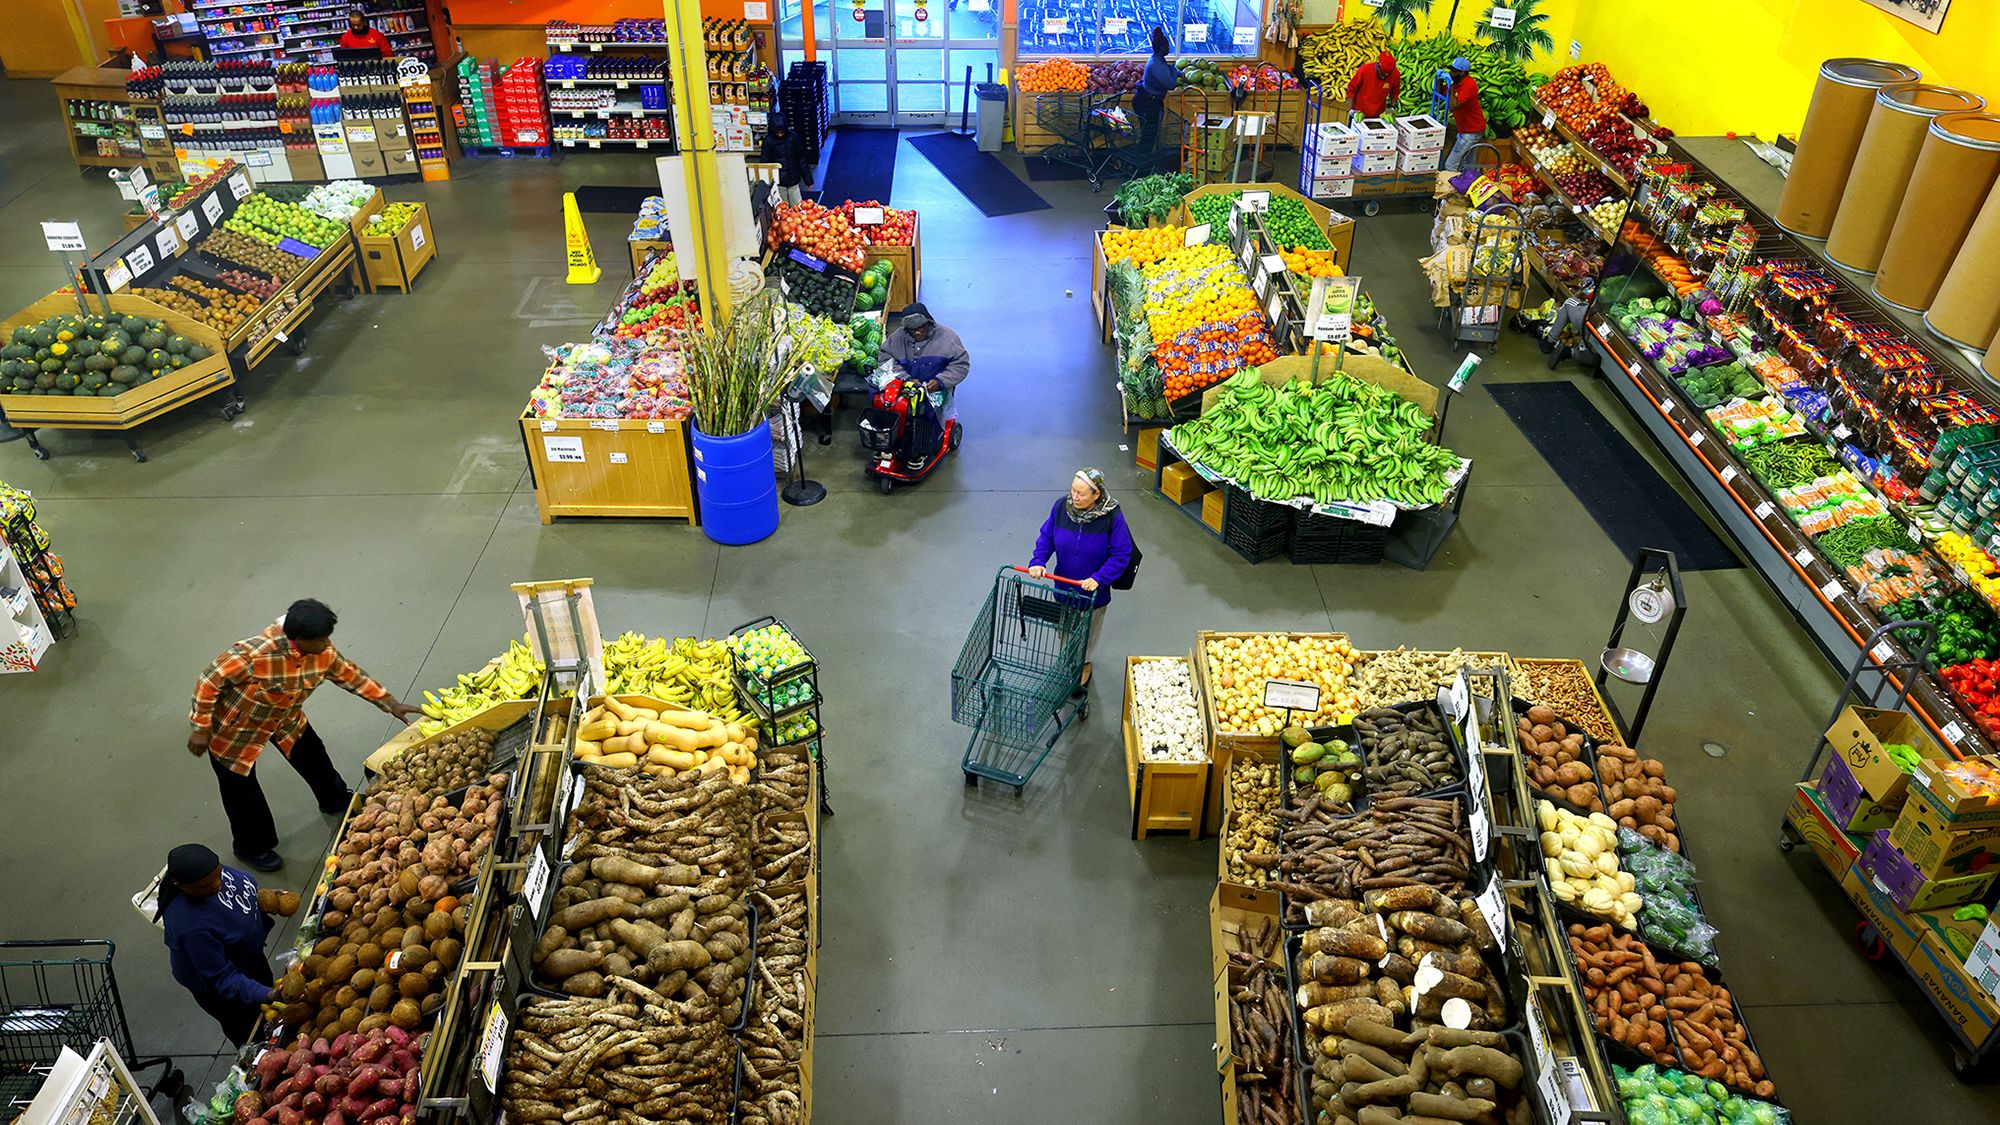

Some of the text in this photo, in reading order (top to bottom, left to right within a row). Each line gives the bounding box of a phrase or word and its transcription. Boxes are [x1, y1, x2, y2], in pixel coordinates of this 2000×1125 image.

[217, 868, 236, 909] best
[1854, 892, 1894, 939] BANANAS
[1922, 972, 1968, 1025] BANANAS
